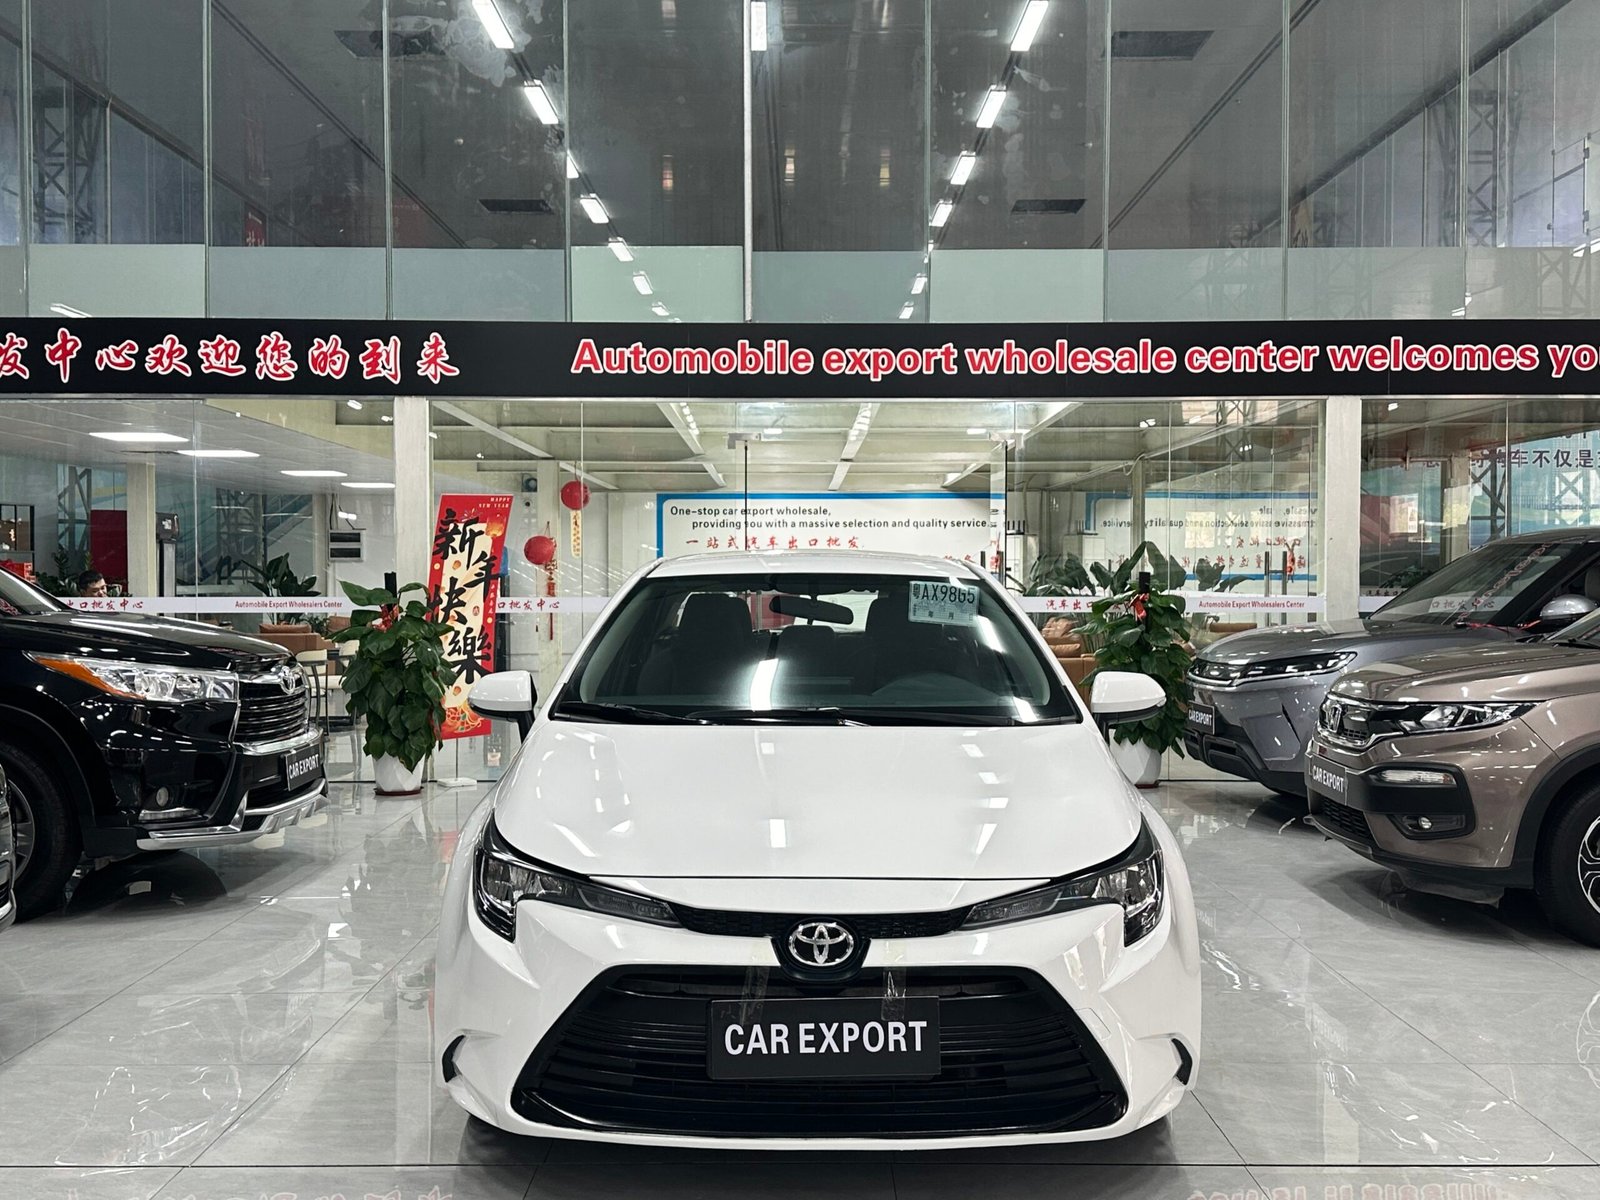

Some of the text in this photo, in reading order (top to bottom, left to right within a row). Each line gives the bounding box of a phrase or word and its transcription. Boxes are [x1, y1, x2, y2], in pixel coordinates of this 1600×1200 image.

[0, 328, 461, 384] 发中心欢迎您的到来
[571, 336, 1600, 382] Automobile export wholesale center welcomes yo
[670, 506, 720, 517] One-stop
[722, 508, 738, 516] car
[776, 506, 832, 517] wholesale,
[692, 518, 741, 530] providing
[765, 519, 788, 529] with
[799, 519, 840, 528] massive
[843, 519, 888, 528] selection
[891, 519, 910, 528] and
[913, 519, 949, 530] quality
[950, 519, 990, 528] service.
[235, 600, 268, 608] Automobile
[269, 600, 288, 609] Export
[324, 600, 342, 608] Center
[1199, 600, 1231, 609] Automobile
[1232, 601, 1251, 610] Export
[1286, 600, 1305, 609] Center
[289, 753, 319, 779] CAR EXPORT
[1312, 765, 1345, 793] CAR EXPORT
[724, 1020, 928, 1056] CAR EXPORT
